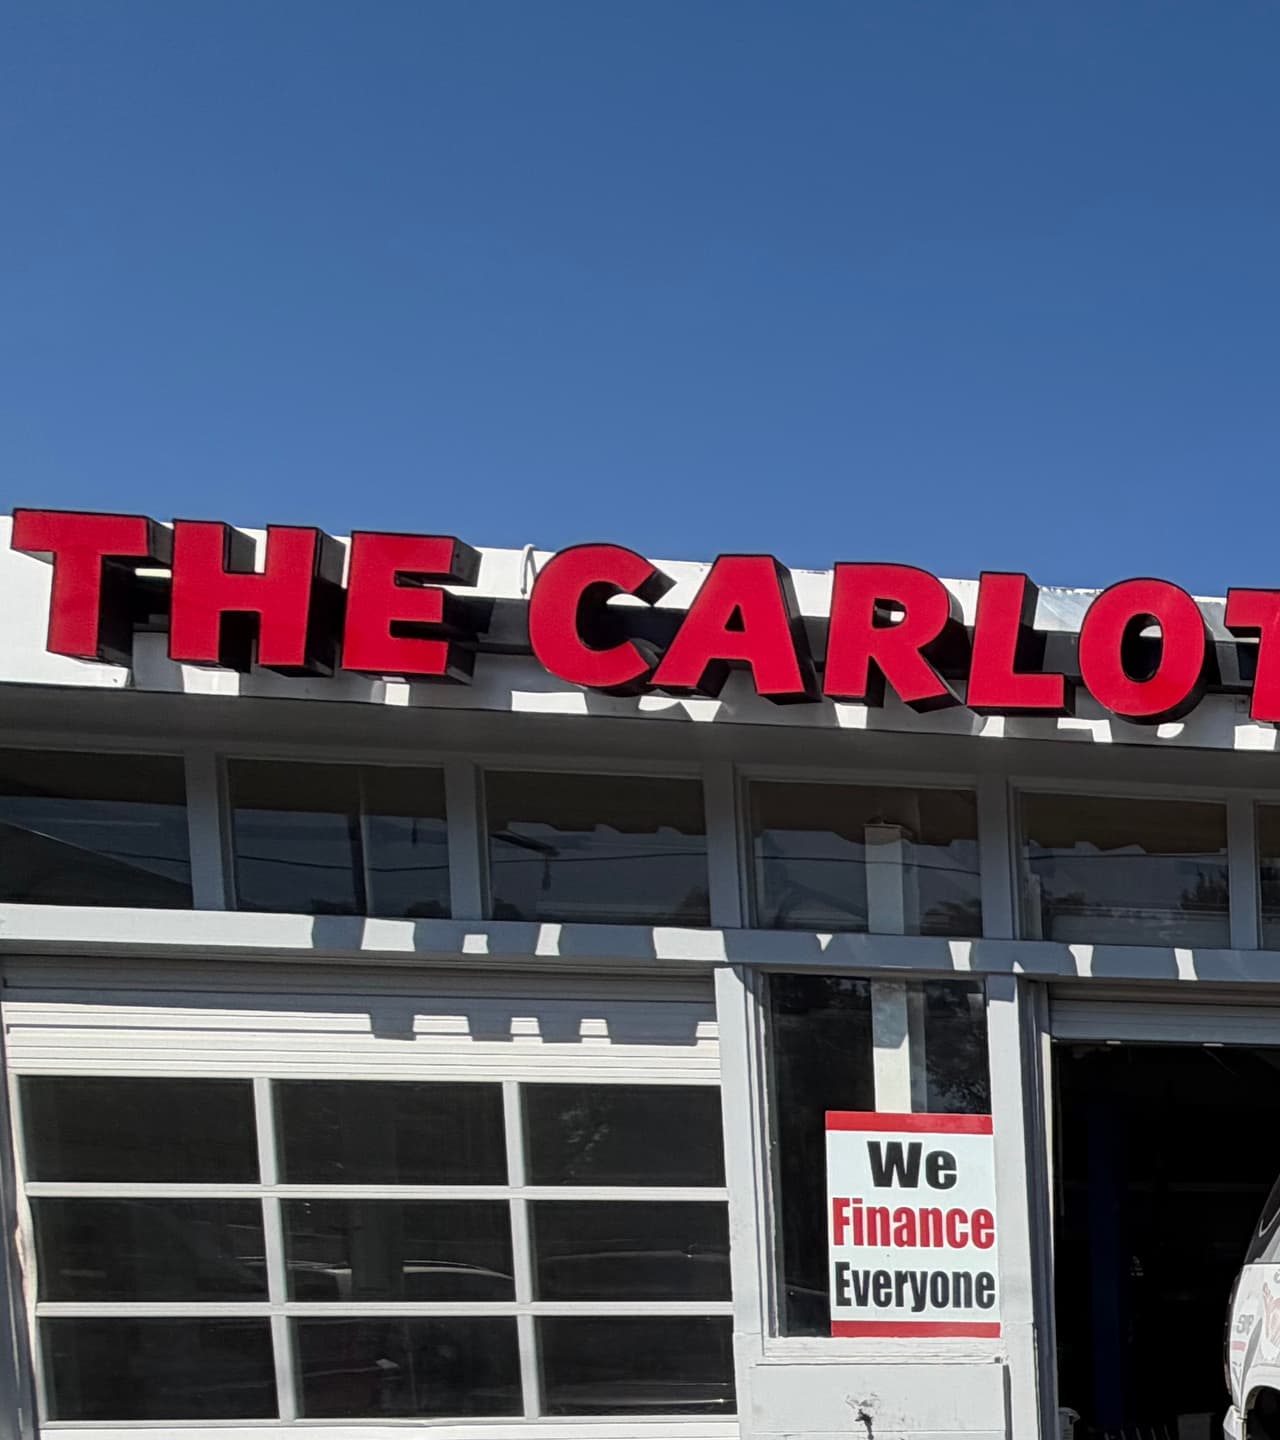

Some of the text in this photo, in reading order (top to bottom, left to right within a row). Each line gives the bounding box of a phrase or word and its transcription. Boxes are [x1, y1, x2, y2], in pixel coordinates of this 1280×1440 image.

[12, 508, 468, 681] THE
[867, 1141, 957, 1190] We
[832, 1198, 995, 1249] Finance
[835, 1262, 995, 1312] Everyone
